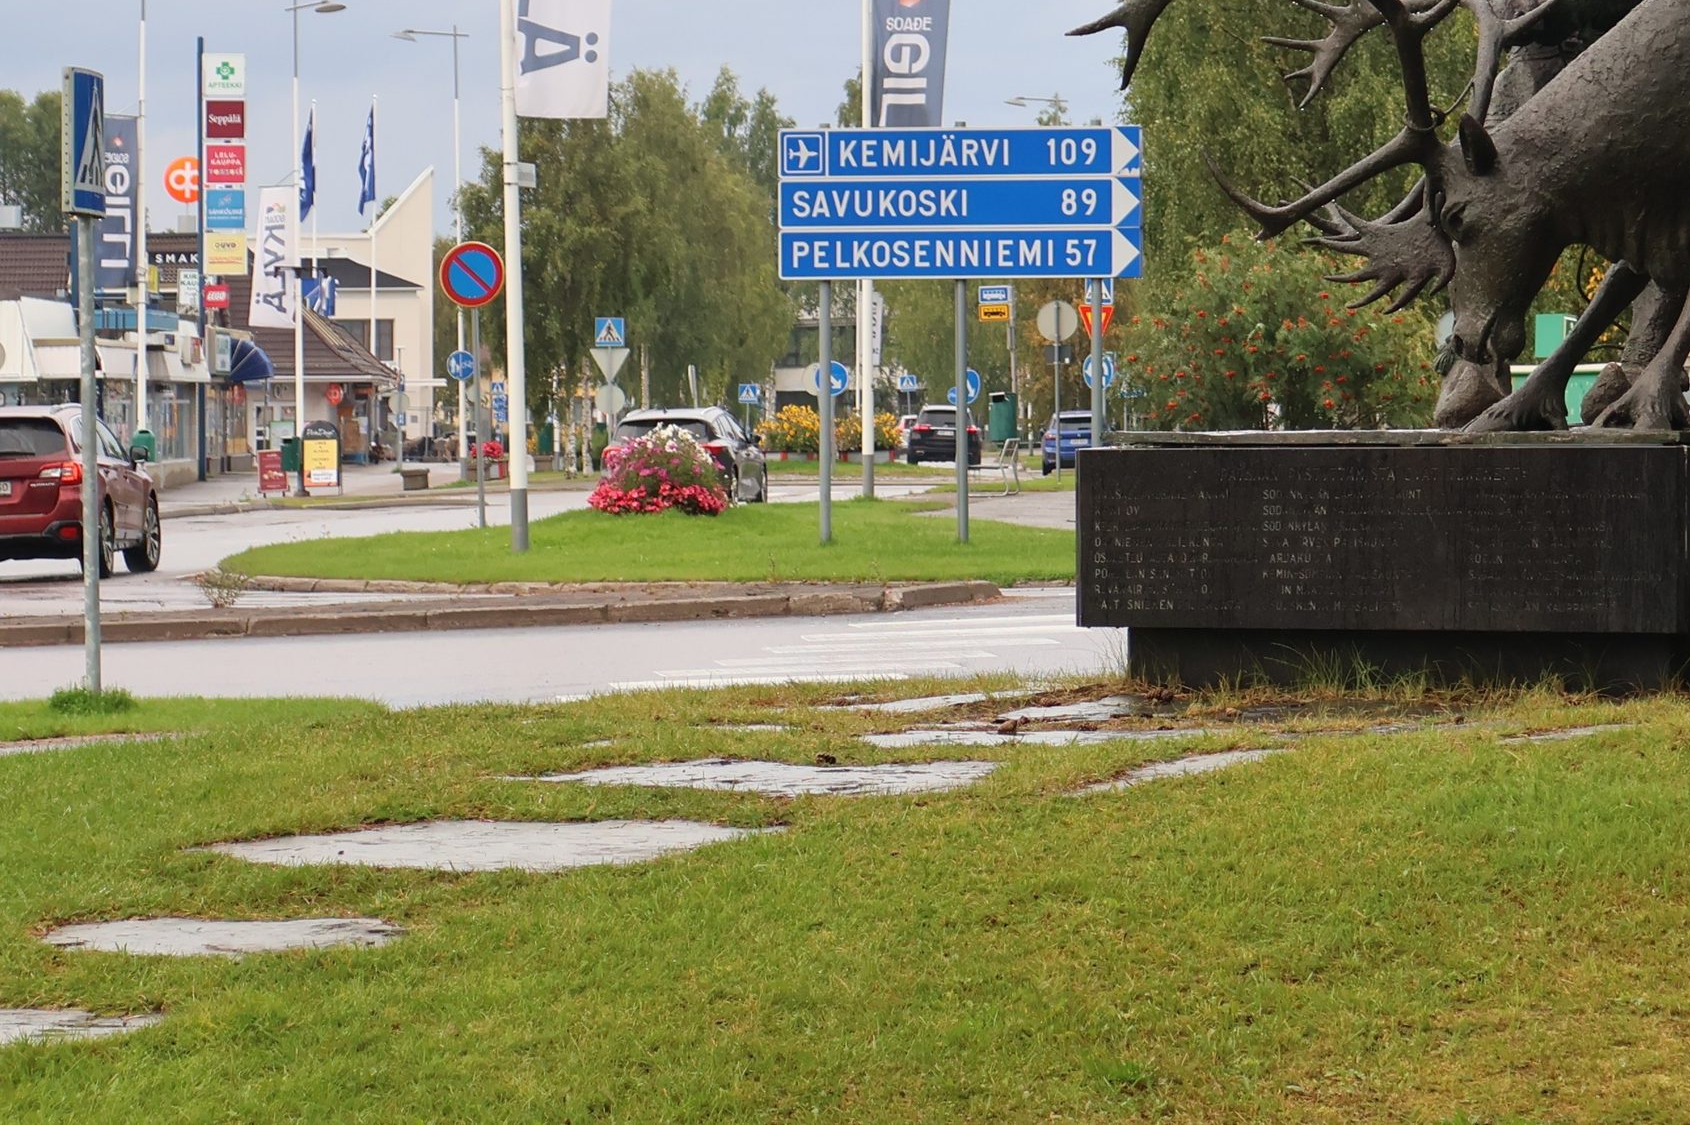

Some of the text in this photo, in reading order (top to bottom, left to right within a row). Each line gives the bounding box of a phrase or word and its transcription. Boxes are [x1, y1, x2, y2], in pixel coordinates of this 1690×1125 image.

[879, 34, 930, 126] GIL
[208, 114, 242, 126] Seppälä
[839, 134, 1097, 167] KEMIJÄRVI 109
[792, 188, 1097, 218] SAVUKOSKI 89
[792, 239, 1097, 268] PELKOSENNIEMI 57
